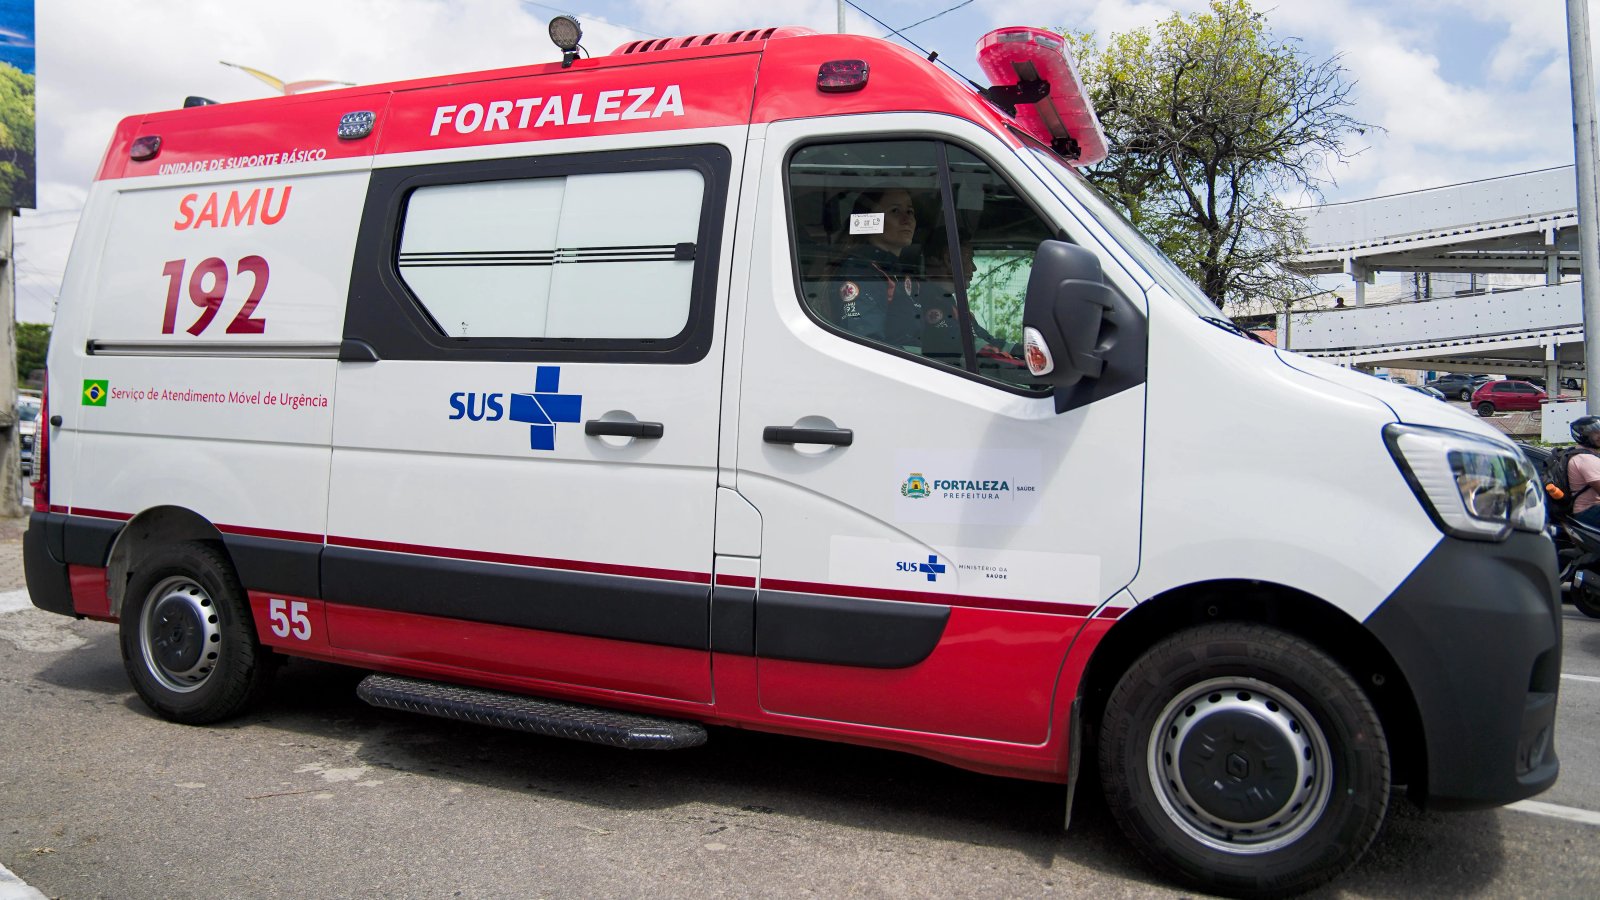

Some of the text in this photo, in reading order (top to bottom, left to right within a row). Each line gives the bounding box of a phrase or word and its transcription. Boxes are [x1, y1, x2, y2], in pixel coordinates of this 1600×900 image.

[430, 84, 684, 136] FORTALEZA
[158, 147, 327, 176] UNIDADE DE SUPORTE BÁSICO
[174, 186, 292, 231] SAMU
[161, 255, 270, 336] 192
[111, 388, 328, 410] Serviço de Atendimento Móvel de Urgência
[449, 392, 504, 421] SUS
[934, 480, 1009, 491] FORTALEZA
[896, 561, 918, 572] SUS
[958, 564, 997, 572] MINISTÉRIO
[269, 598, 312, 641] 55
